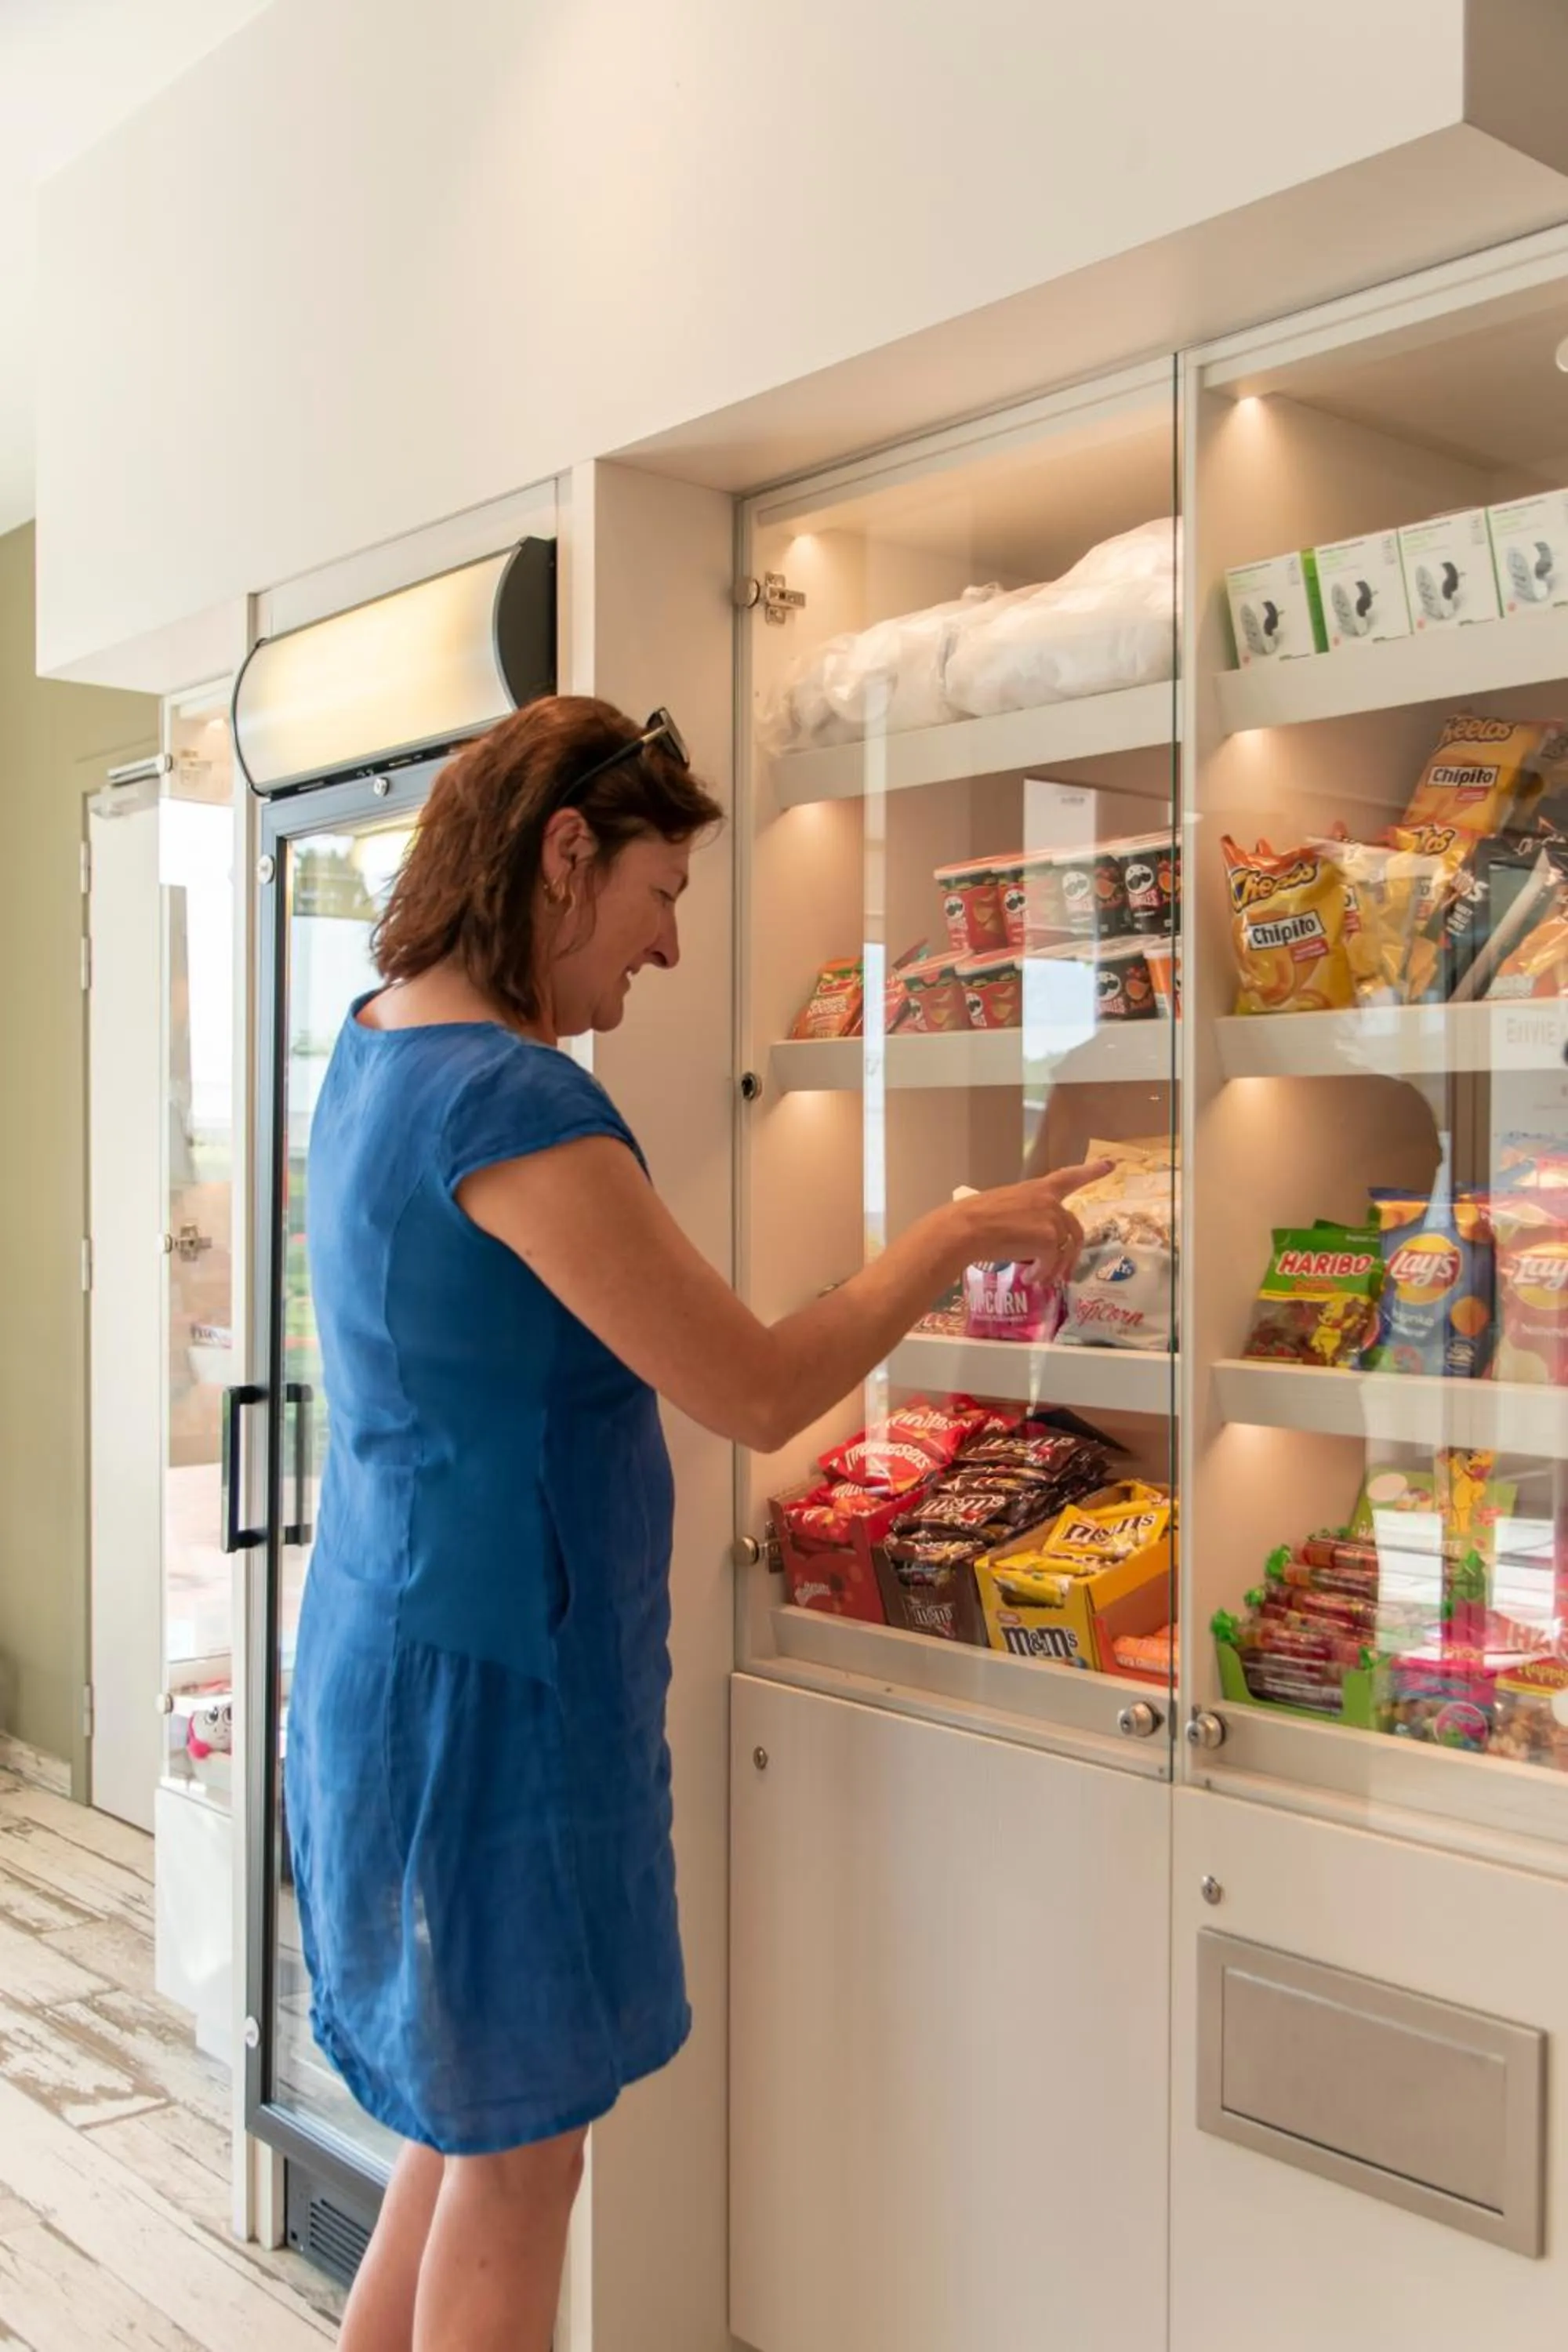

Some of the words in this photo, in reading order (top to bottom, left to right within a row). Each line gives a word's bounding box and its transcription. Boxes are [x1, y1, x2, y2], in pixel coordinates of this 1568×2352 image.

[1433, 768, 1494, 788] Chipito
[1252, 919, 1316, 946] Chipito
[1276, 1251, 1374, 1277] HARIBO
[1391, 1250, 1457, 1287] Lay's
[1513, 1257, 1568, 1290] Lay
